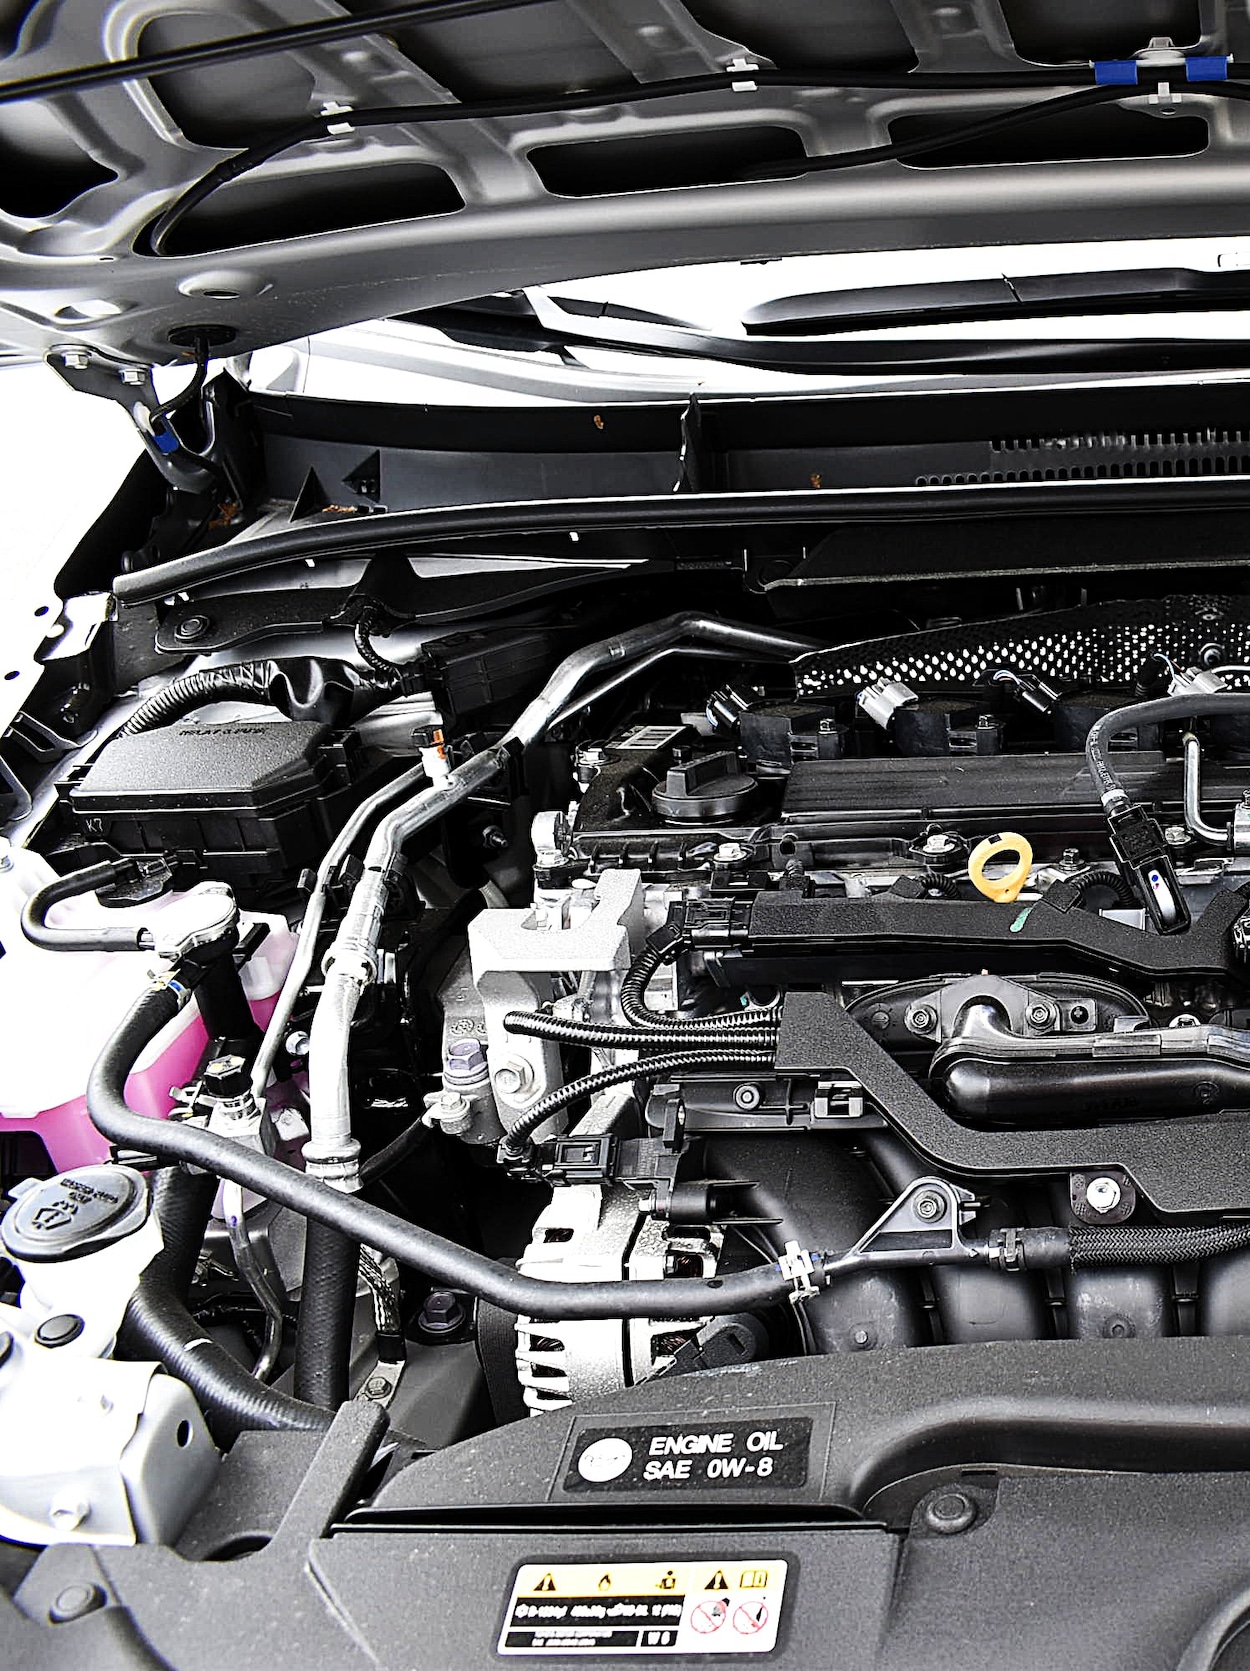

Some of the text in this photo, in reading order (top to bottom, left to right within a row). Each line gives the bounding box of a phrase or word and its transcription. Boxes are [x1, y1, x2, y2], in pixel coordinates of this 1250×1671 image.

[85, 817, 103, 832] K7
[649, 1430, 784, 1456] ENGINE OIL
[643, 1456, 774, 1480] SAE 0W-8
